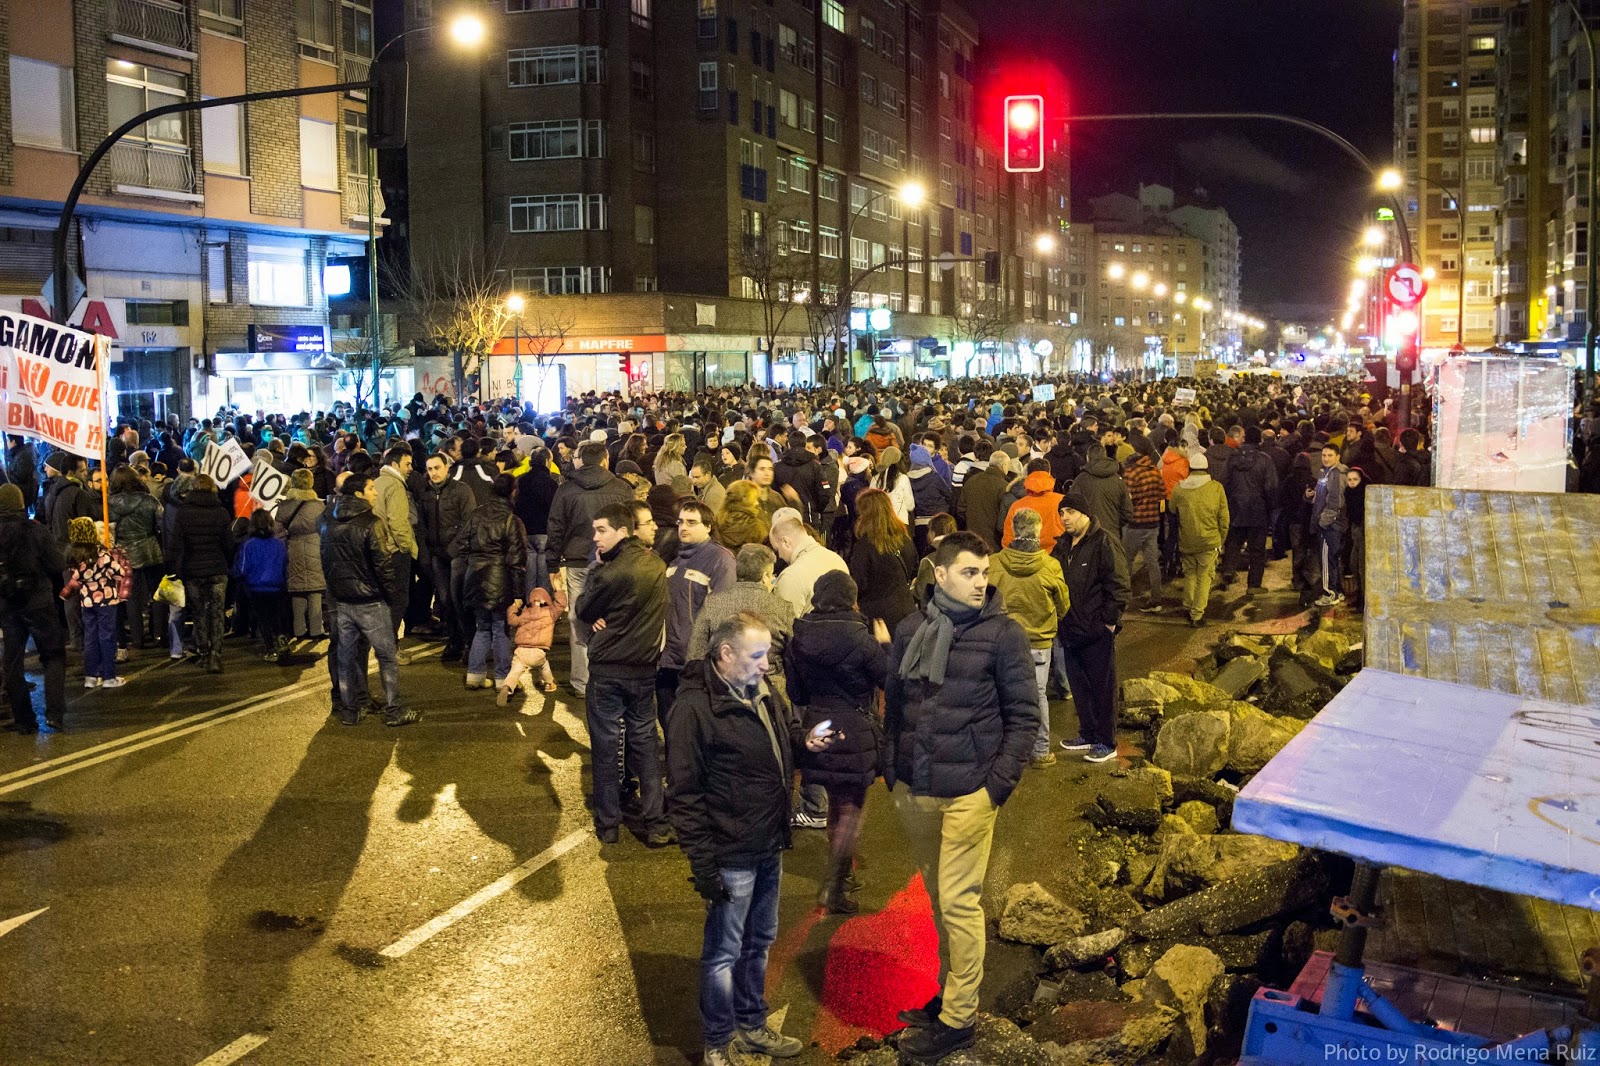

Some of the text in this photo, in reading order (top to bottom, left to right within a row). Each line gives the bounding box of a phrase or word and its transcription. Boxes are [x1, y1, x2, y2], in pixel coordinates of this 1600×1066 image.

[0, 315, 97, 371] GAMON
[579, 339, 634, 350] MAPFRE
[17, 356, 51, 398] NO
[8, 402, 79, 446] BULEVAR
[202, 444, 232, 482] NO
[251, 461, 283, 501] NO
